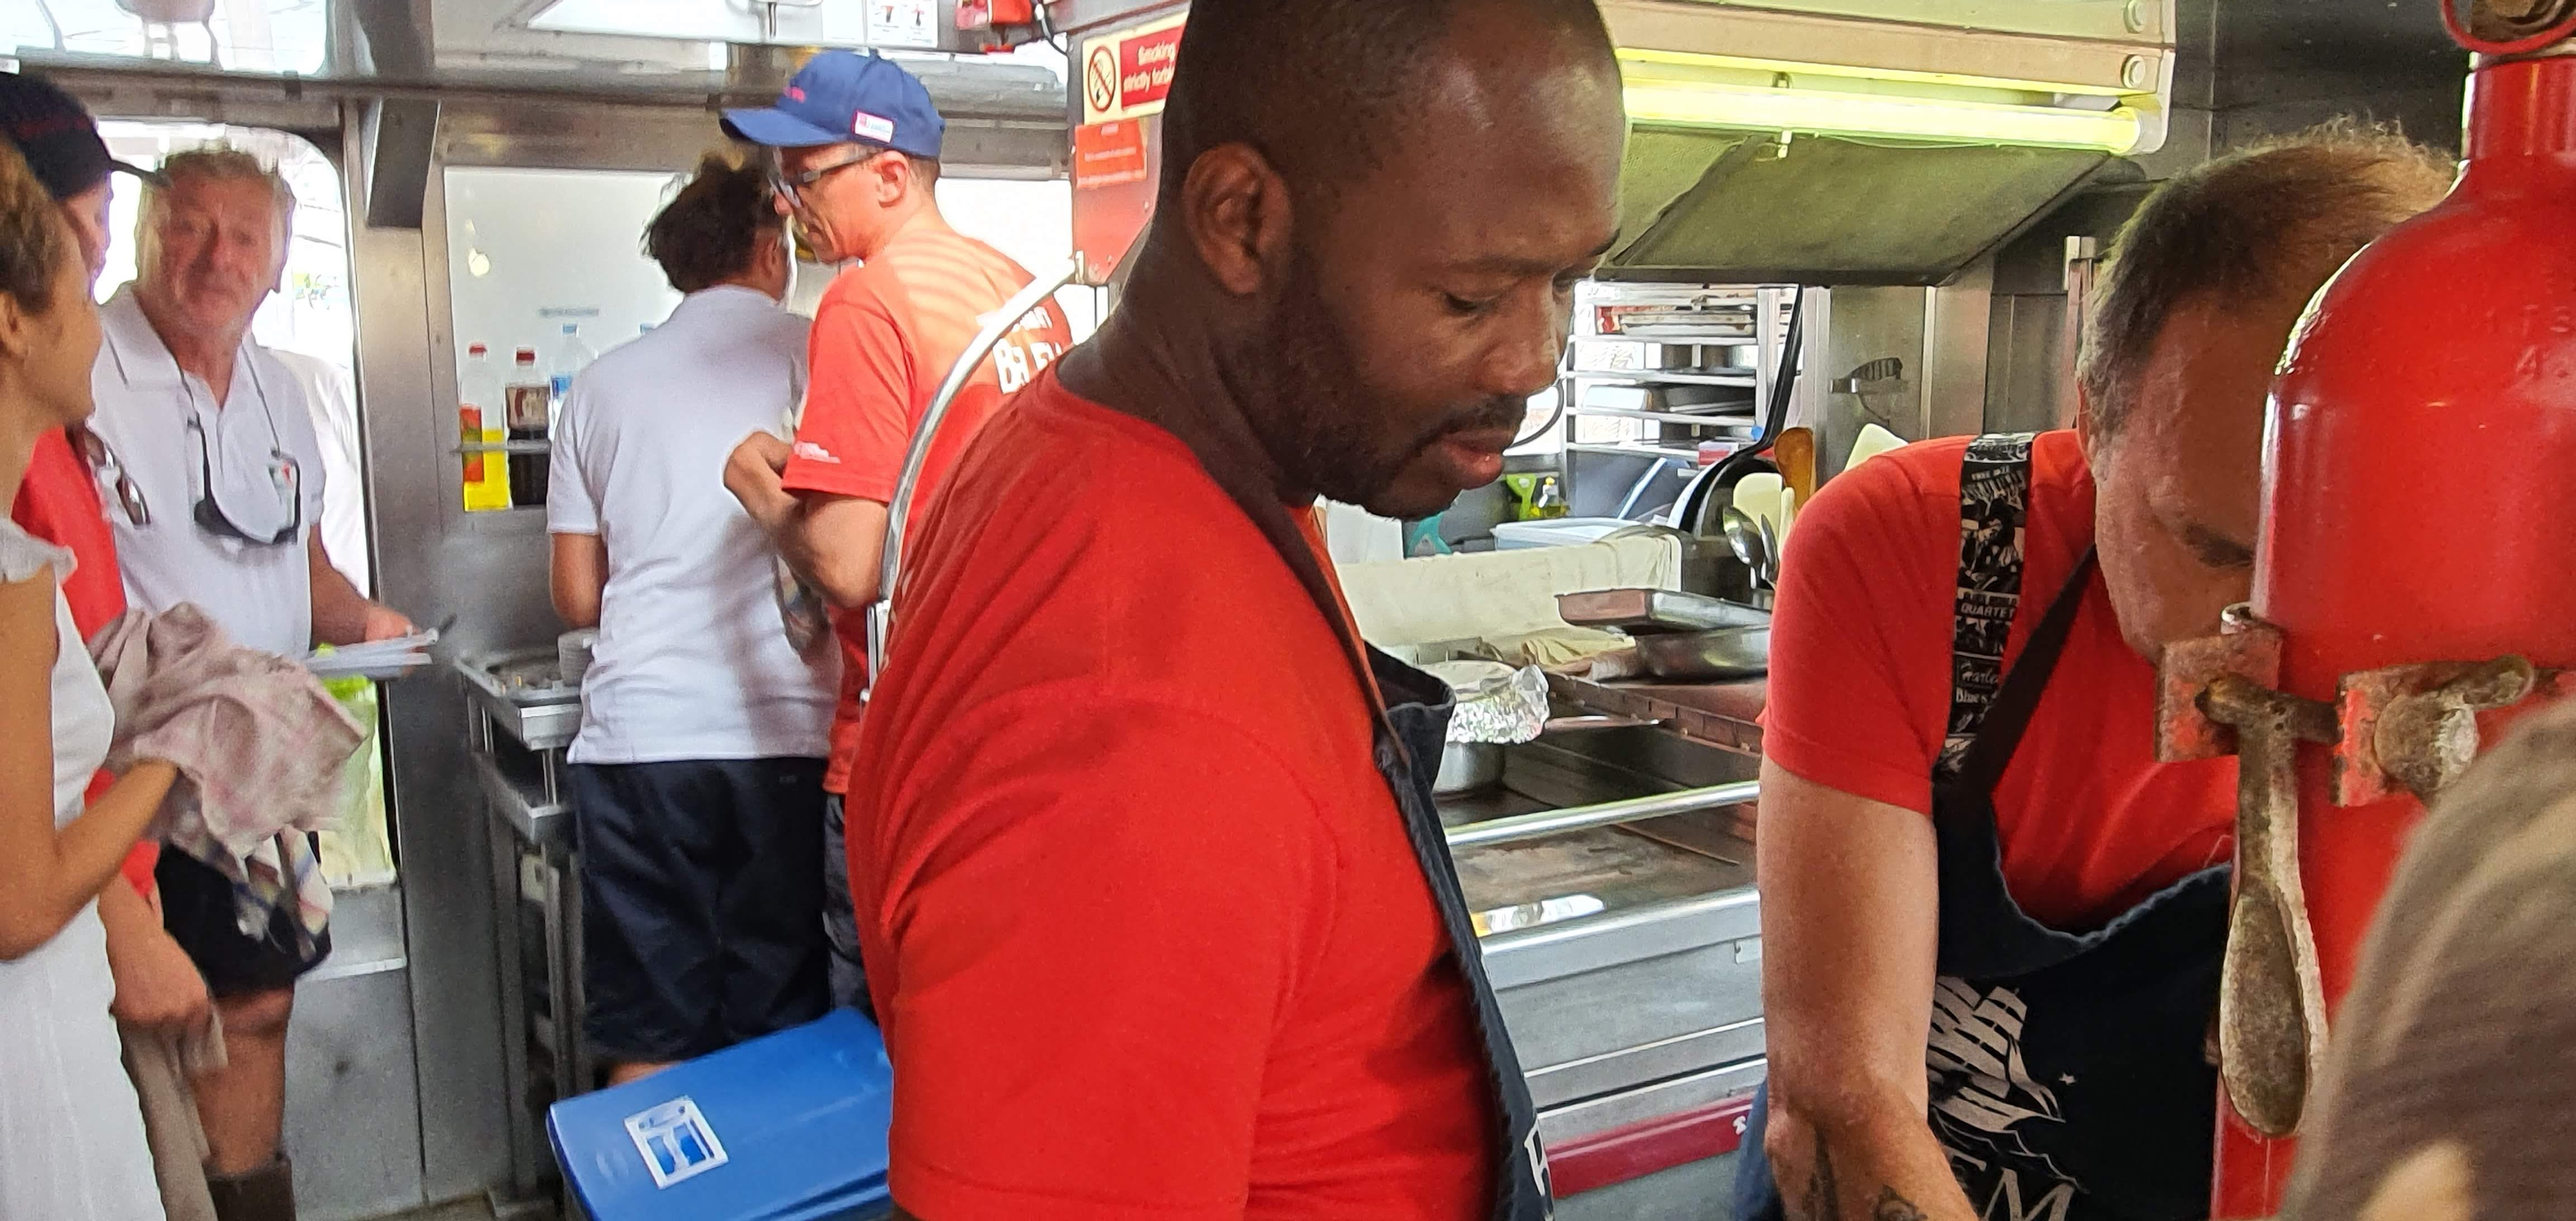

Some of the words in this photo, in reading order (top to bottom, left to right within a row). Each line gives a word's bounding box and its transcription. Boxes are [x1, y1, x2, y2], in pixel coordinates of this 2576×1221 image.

[1138, 40, 1176, 66] Smoking
[1123, 71, 1151, 93] strictly
[1961, 602, 2015, 619] QUARTET
